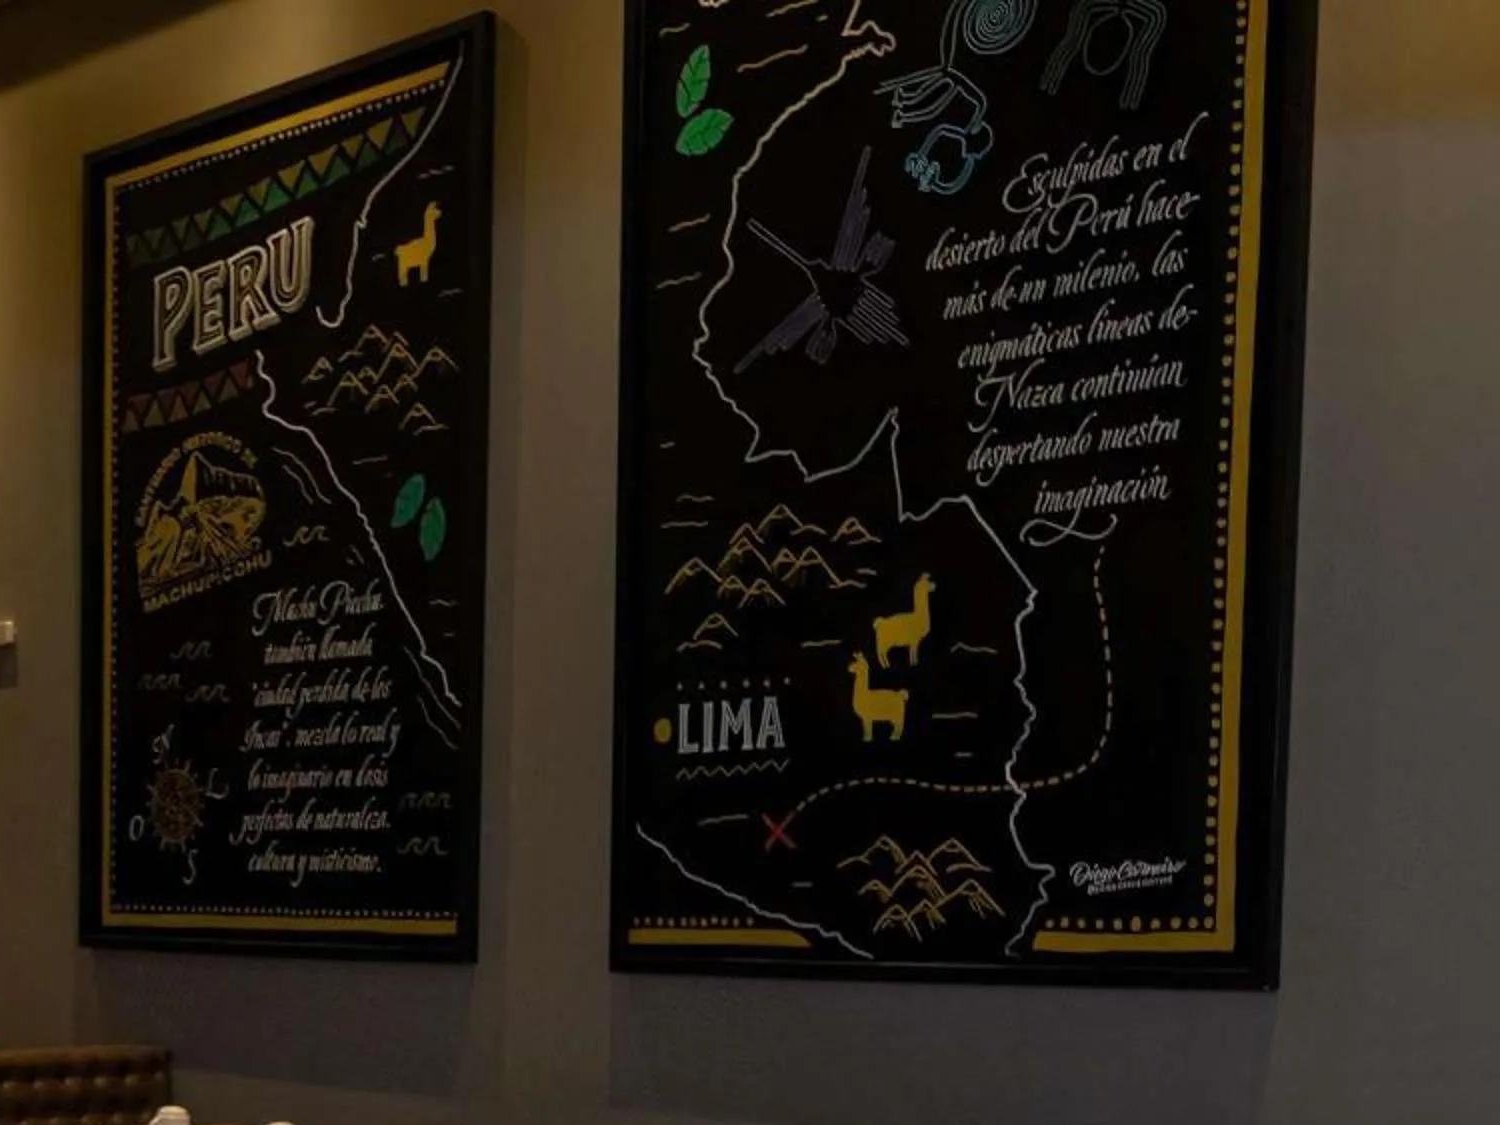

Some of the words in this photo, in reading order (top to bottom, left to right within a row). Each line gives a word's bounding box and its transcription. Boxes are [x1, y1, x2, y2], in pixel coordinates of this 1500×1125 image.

[1002, 135, 1128, 214] Esculpidas
[1133, 143, 1163, 172] en
[1168, 111, 1209, 163] el
[925, 227, 1006, 271] desierto
[1009, 206, 1050, 256] del
[1046, 193, 1134, 254] Perú
[1136, 178, 1201, 229] hace
[152, 215, 315, 373] PERU
[943, 280, 987, 321] más
[991, 264, 1018, 312] de
[1018, 277, 1047, 303] un
[1053, 248, 1141, 298] milenio,
[1151, 229, 1189, 278] las
[957, 321, 1083, 380] enigmáticas
[1159, 283, 1198, 331] de
[967, 357, 1063, 432] Nazca
[1071, 353, 1188, 402] continúan
[966, 410, 1098, 487] despertando
[1100, 414, 1181, 452] nuestra
[1020, 464, 1173, 540] imaginación
[252, 586, 318, 637] Machu
[264, 630, 317, 665] también
[318, 622, 377, 661] llamada
[285, 667, 351, 720] perdida
[351, 665, 373, 703] de
[371, 664, 393, 700] los
[293, 710, 343, 748] mezcla
[341, 708, 361, 747] lo
[358, 706, 399, 745] real
[380, 723, 402, 759] y
[675, 695, 788, 755] LIMA
[203, 766, 231, 801] L
[247, 756, 265, 793] lo
[262, 762, 335, 805] imaginario
[334, 767, 354, 790] en
[126, 813, 146, 843] O
[295, 795, 319, 832] de
[180, 846, 201, 887] S
[247, 838, 296, 873] cultura
[288, 852, 308, 889] y
